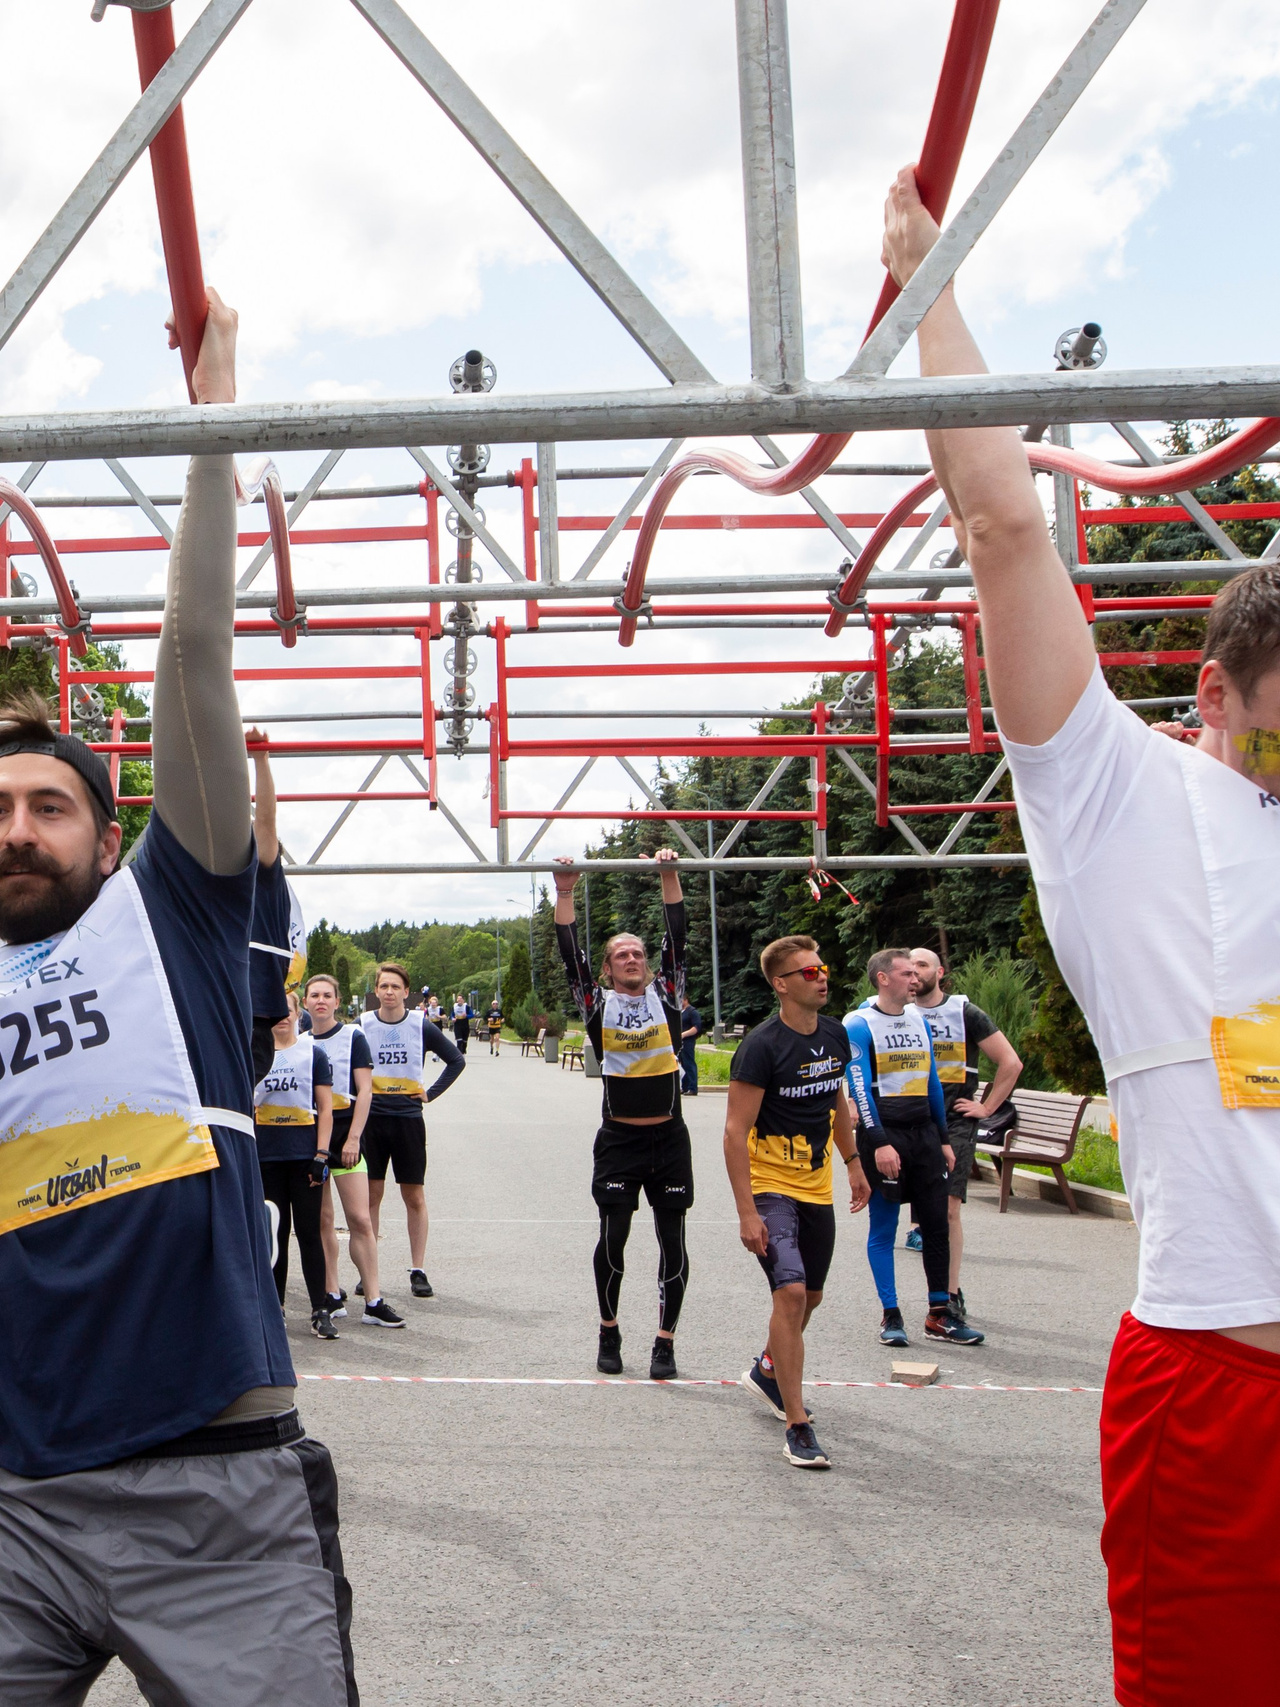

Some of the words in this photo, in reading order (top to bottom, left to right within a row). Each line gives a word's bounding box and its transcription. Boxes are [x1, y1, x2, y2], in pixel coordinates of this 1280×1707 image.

[614, 1025, 660, 1042] КОМАНДНЫЙ
[884, 1033, 923, 1049] 1125-3
[626, 1040, 649, 1050] СТАРТ
[378, 1051, 408, 1065] 5253
[888, 1051, 926, 1062] КОМАНДНЫЙ
[900, 1061, 920, 1070] СТАРТ
[264, 1076, 299, 1093] 5264
[1245, 1074, 1280, 1084] ГОНКА
[849, 1064, 876, 1129] GAZPROMBANK
[17, 1194, 42, 1208] ГОНКА
[46, 1153, 108, 1207] URBAN
[109, 1162, 141, 1177] ГЕРОЕВ
